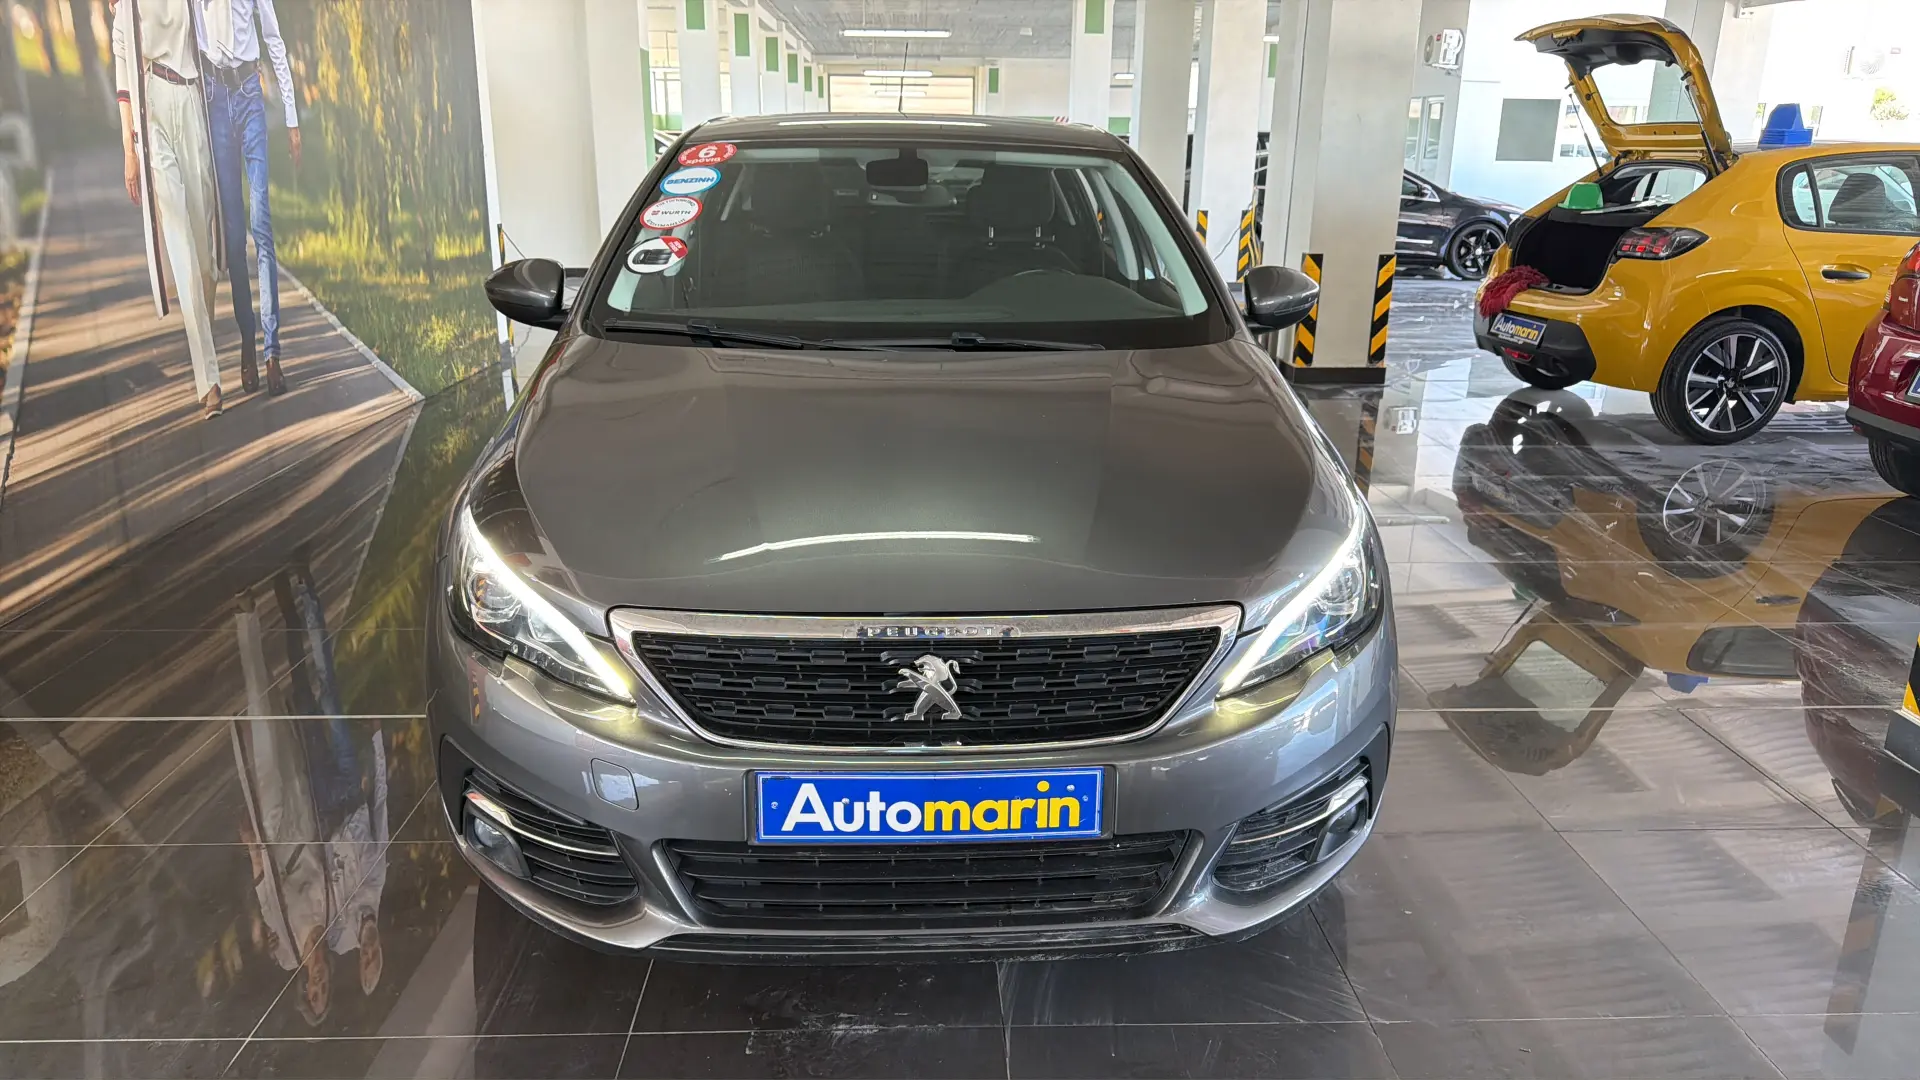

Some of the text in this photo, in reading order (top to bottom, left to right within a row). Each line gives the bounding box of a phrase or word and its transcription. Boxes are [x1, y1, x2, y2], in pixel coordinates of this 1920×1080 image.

[1495, 316, 1539, 340] Automarin
[866, 626, 996, 637] PEUGEOT
[781, 780, 1081, 832] Automarin
